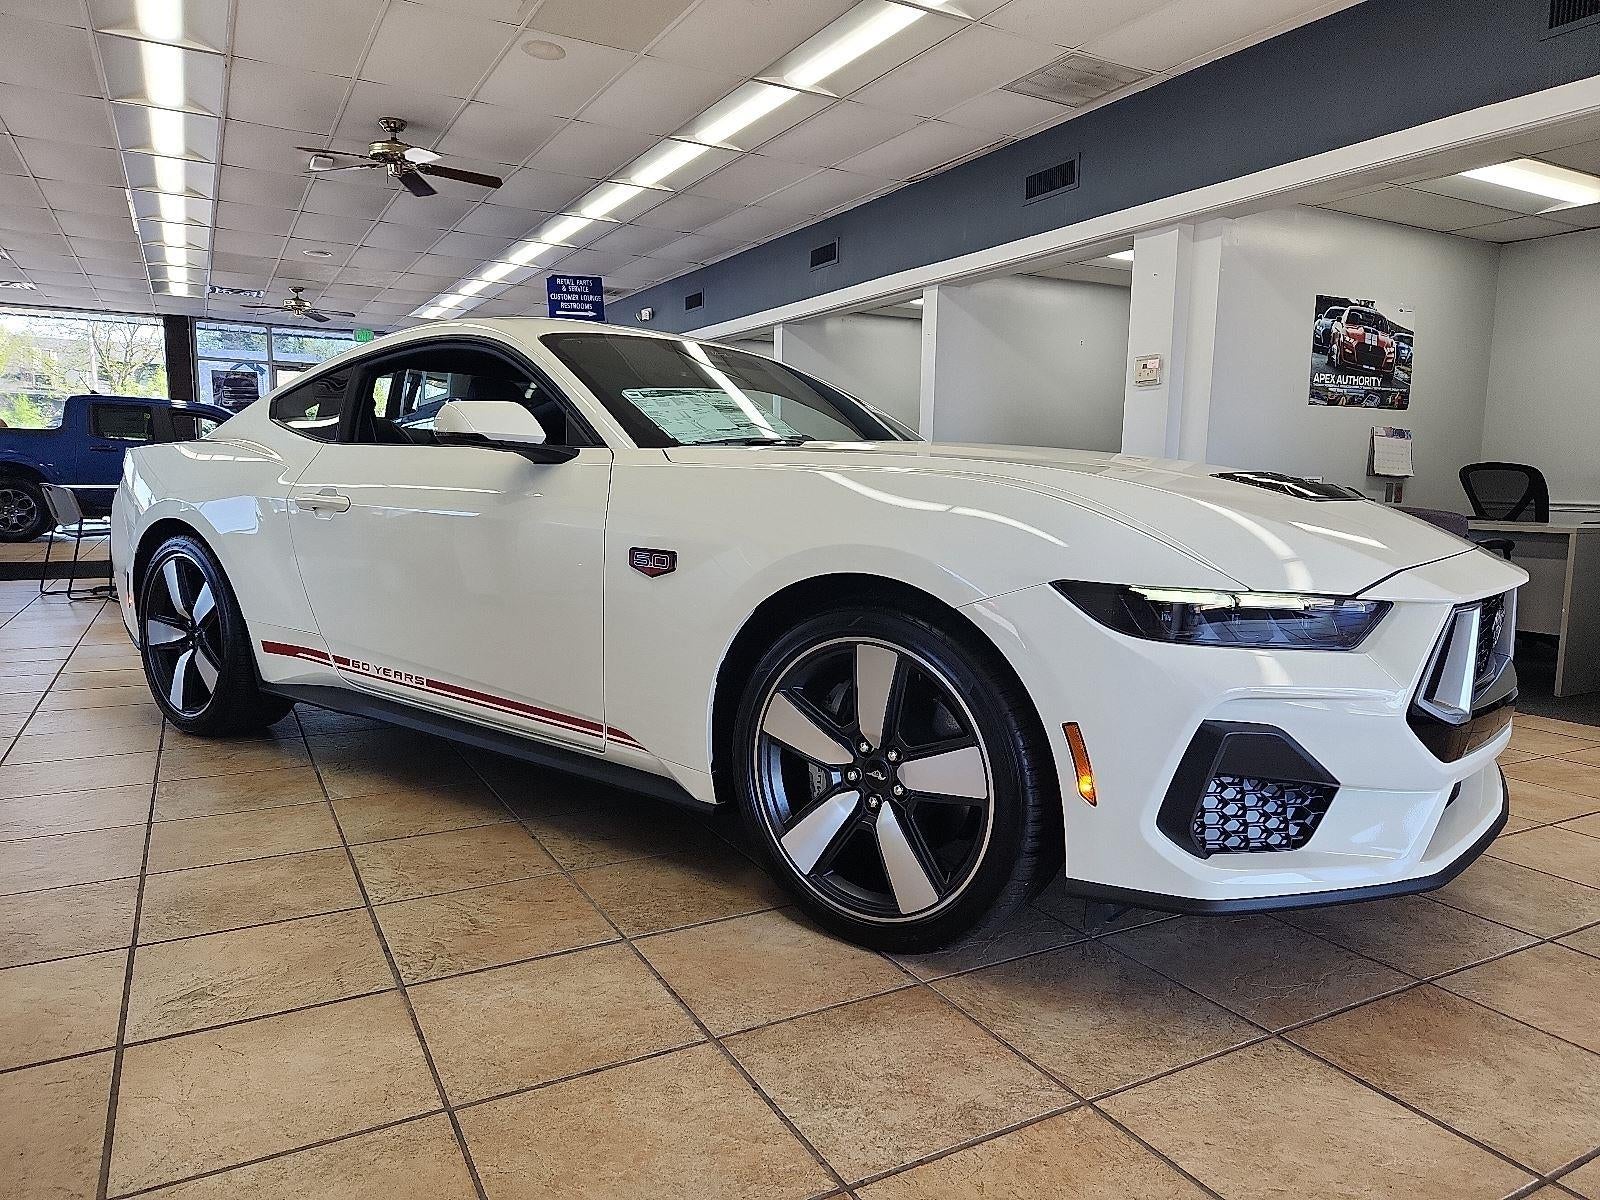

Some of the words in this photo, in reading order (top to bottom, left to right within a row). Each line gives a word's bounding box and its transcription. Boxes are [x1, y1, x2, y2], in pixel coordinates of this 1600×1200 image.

[556, 278, 575, 286] RETAIL
[576, 279, 593, 287] PARTS
[568, 285, 589, 293] SERVICE
[550, 293, 579, 301] CUSTOMER
[580, 294, 602, 302] LOUNGE
[560, 302, 593, 310] RESTROOMS
[1313, 373, 1336, 384] APEX
[1336, 374, 1383, 387] AUTHORITY
[351, 659, 370, 672] 60
[373, 664, 425, 686] YEARS
